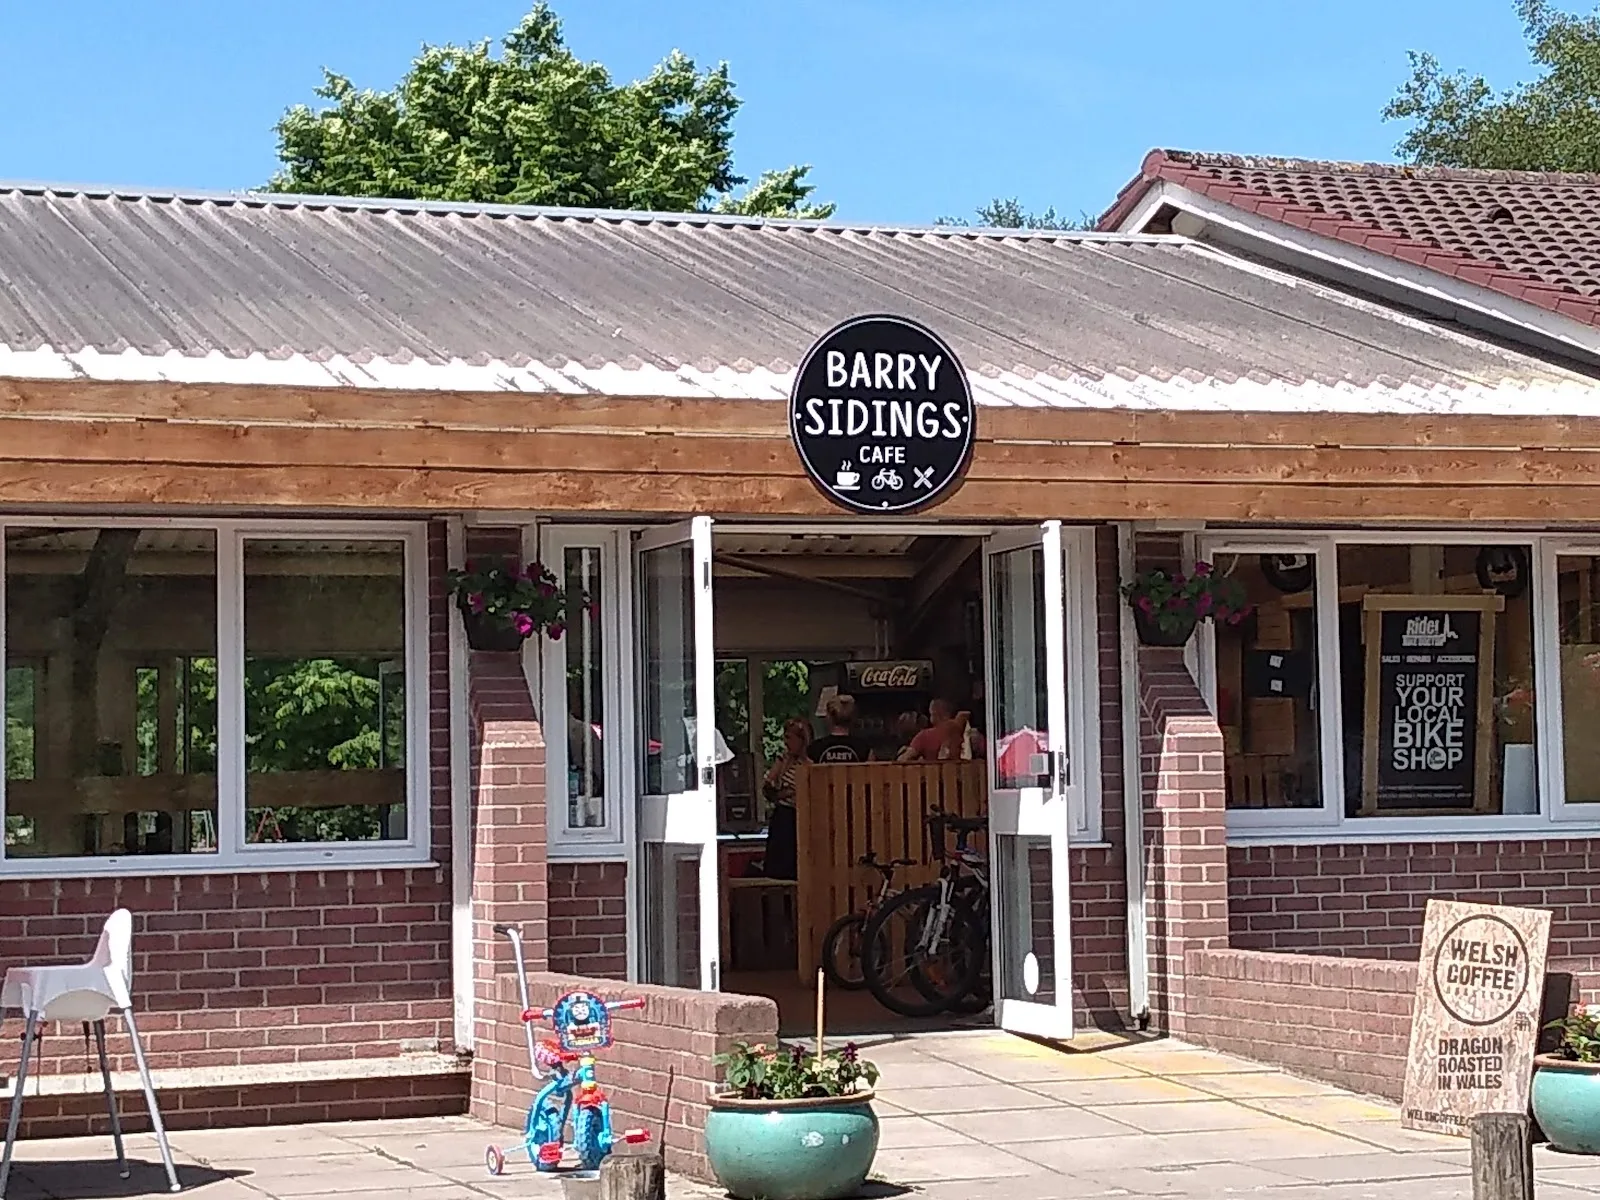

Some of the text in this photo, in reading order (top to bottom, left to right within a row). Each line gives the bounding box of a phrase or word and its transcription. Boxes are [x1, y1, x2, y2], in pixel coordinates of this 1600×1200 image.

[826, 350, 942, 391] BARRY
[804, 398, 962, 438] SIDINGS
[859, 446, 906, 464] CAFE
[1396, 673, 1465, 687] SUPPORT
[1396, 686, 1465, 708] YOUR
[1394, 705, 1465, 724] LOCAL
[1393, 721, 1464, 748] BIKE
[1392, 747, 1464, 770] SHOP
[1450, 938, 1519, 968] WELSH
[1446, 963, 1516, 991] COFFEE
[1438, 1036, 1503, 1056] DRAGON
[1438, 1056, 1503, 1074] ROASTED
[1437, 1074, 1503, 1091] IN WALES
